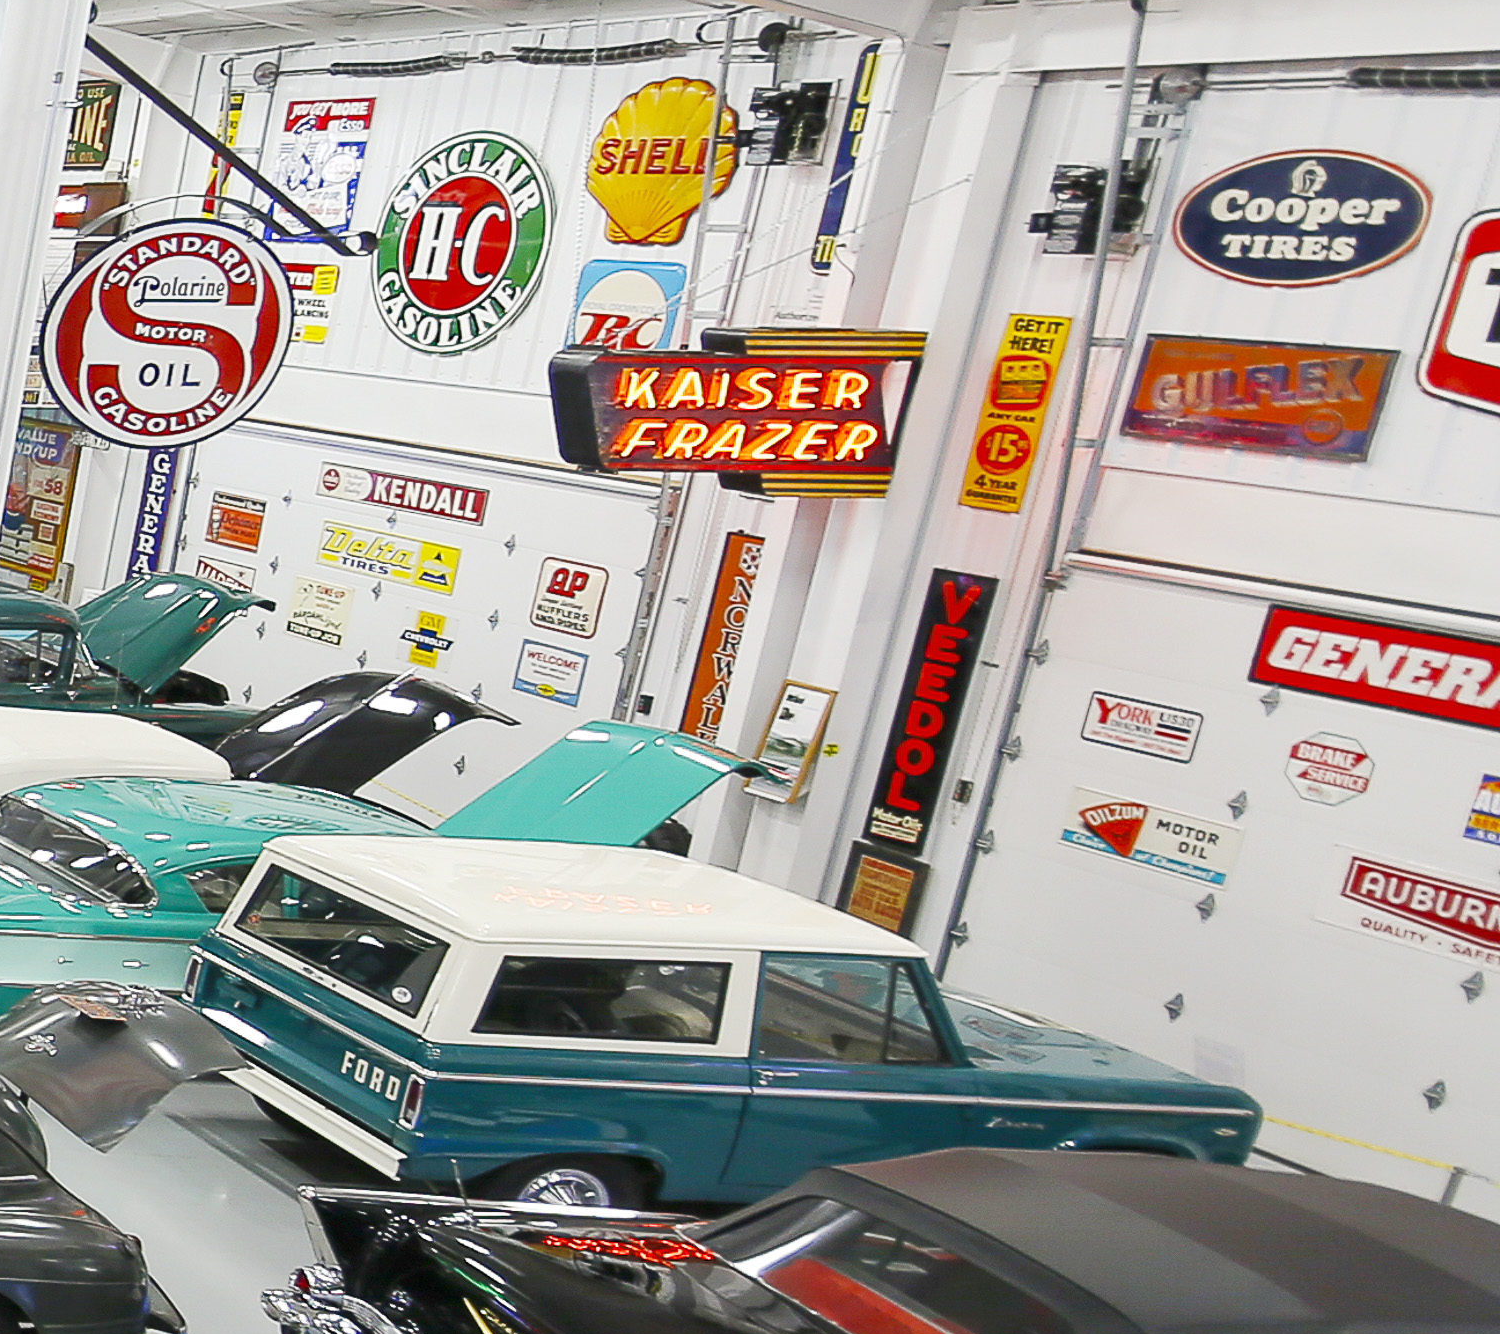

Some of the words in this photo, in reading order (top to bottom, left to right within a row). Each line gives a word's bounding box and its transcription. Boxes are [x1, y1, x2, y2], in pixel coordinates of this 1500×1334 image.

[332, 101, 369, 117] MORE
[595, 137, 707, 175] SHELL
[395, 143, 542, 221] SINCLAIR
[1210, 188, 1402, 230] Cooper
[409, 201, 505, 286] H-C
[1221, 234, 1358, 262] TIRES
[133, 275, 226, 306] Polarine
[379, 271, 522, 349] GASOLINE
[135, 323, 206, 343] MOTOR
[1014, 319, 1043, 335] GET
[1045, 320, 1065, 334] IT
[1009, 335, 1054, 354] HERE!
[140, 363, 200, 388] OIL
[621, 368, 869, 411] KAISER
[1150, 357, 1365, 412] GULFLEX
[94, 386, 234, 435] GASOLINE
[1014, 414, 1036, 424] CAR
[619, 420, 878, 461] FRAZER
[373, 475, 478, 519] KENDALL
[987, 480, 1018, 492] YEAR
[321, 527, 414, 566] Delta
[339, 556, 389, 575] TIRES
[546, 567, 589, 599] AP
[536, 602, 590, 623] MUFFLERS
[404, 630, 450, 650] CHEVROLET
[526, 648, 580, 671] WELCOME
[886, 580, 981, 812] VEEDOL
[1096, 697, 1155, 725] YORK
[1299, 743, 1358, 768] BRAKE
[1307, 767, 1368, 792] SERVICE
[1085, 805, 1145, 826] OILZUM
[1156, 819, 1220, 846] MOTOR
[1178, 842, 1208, 860] OIL
[1360, 916, 1428, 945] QUALITY
[340, 1050, 401, 1102] FORD
